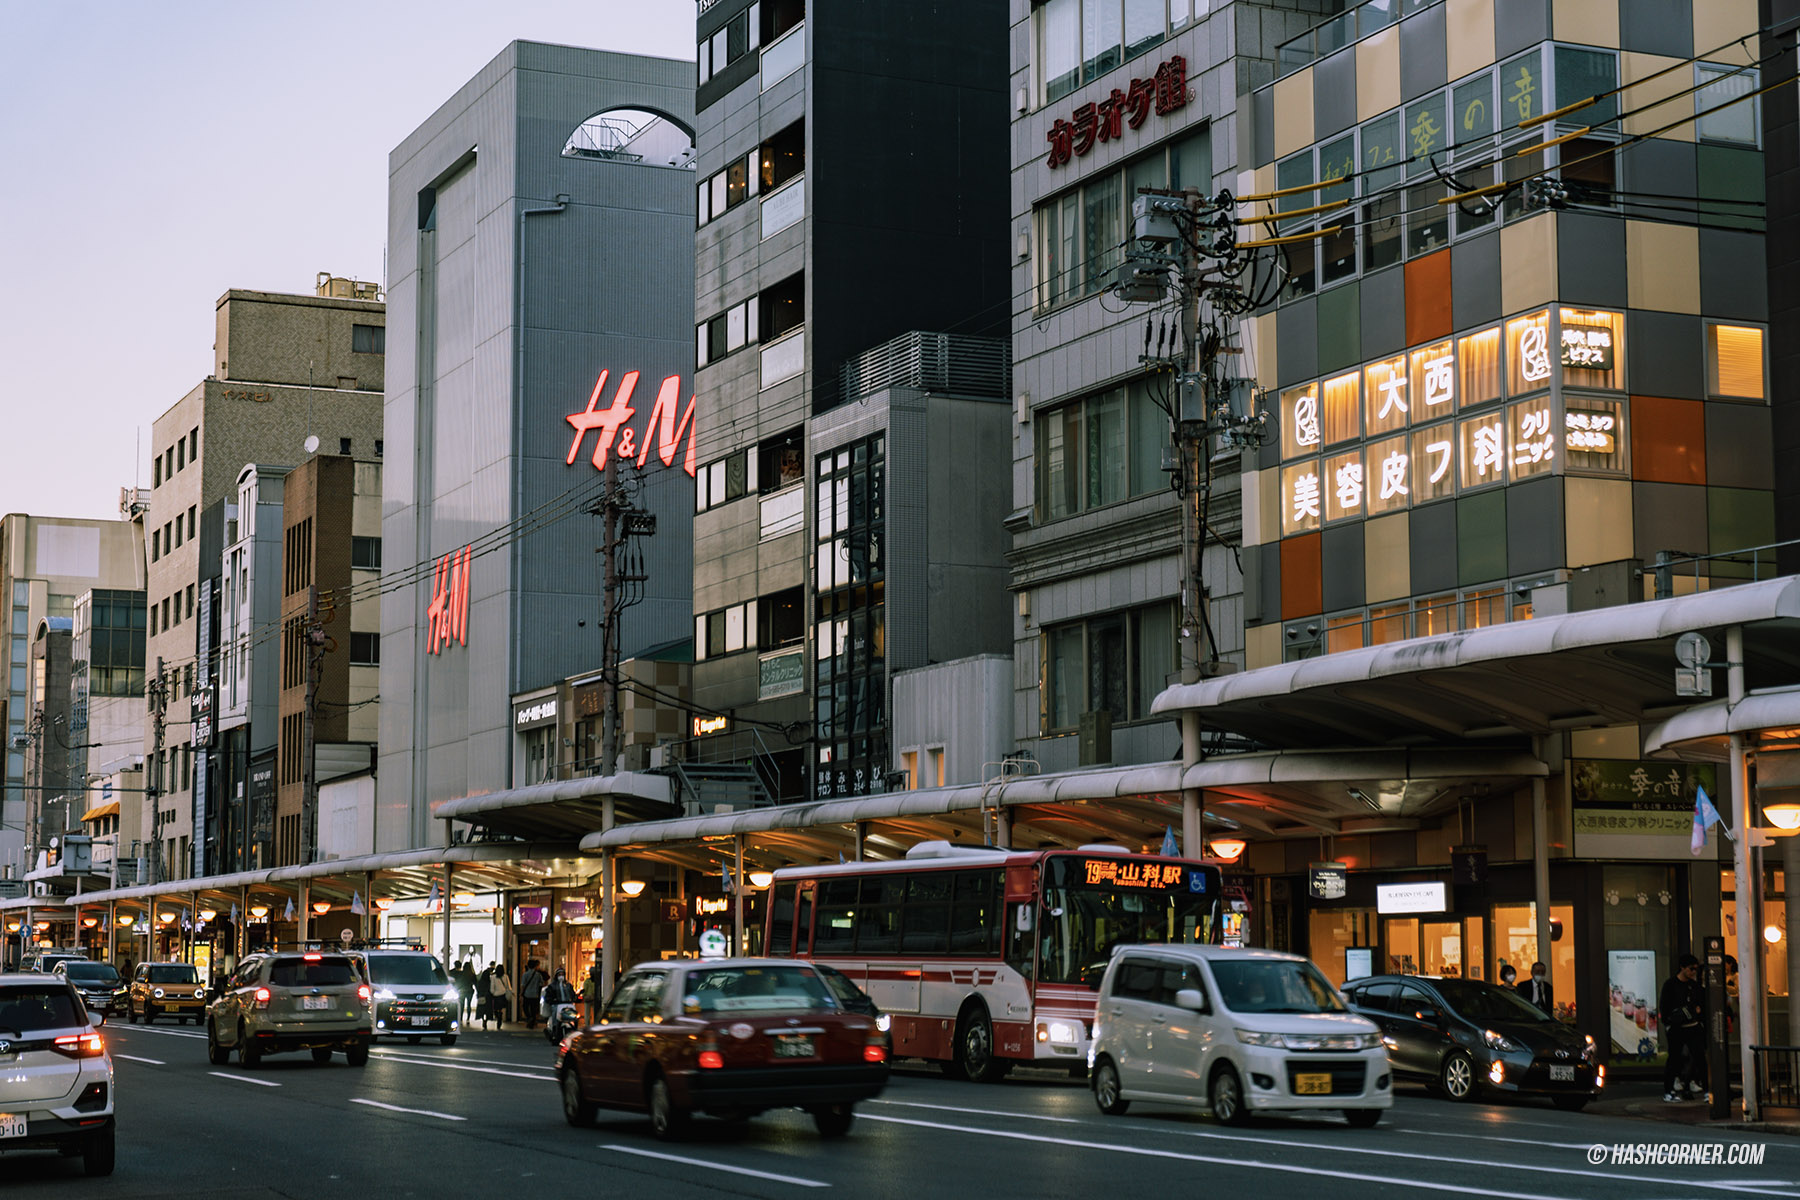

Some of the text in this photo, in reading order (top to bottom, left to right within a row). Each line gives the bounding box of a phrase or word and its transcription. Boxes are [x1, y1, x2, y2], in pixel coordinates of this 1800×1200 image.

[1047, 55, 1186, 169] カラオケ館
[1410, 67, 1536, 162] 季の音
[1569, 346, 1604, 362] ピアス
[1378, 355, 1454, 420] 大西
[566, 369, 696, 477] H&M
[1294, 422, 1504, 522] 美容皮フ科
[427, 544, 471, 655] H&M
[694, 717, 702, 737] R
[837, 765, 882, 784] みやび
[1629, 767, 1682, 797] 季の音
[817, 784, 832, 797] サロン
[837, 784, 847, 793] TEL
[1576, 816, 1691, 830] 大西美容皮フ科クリニック
[1087, 862, 1100, 883] 19
[696, 896, 704, 916] R
